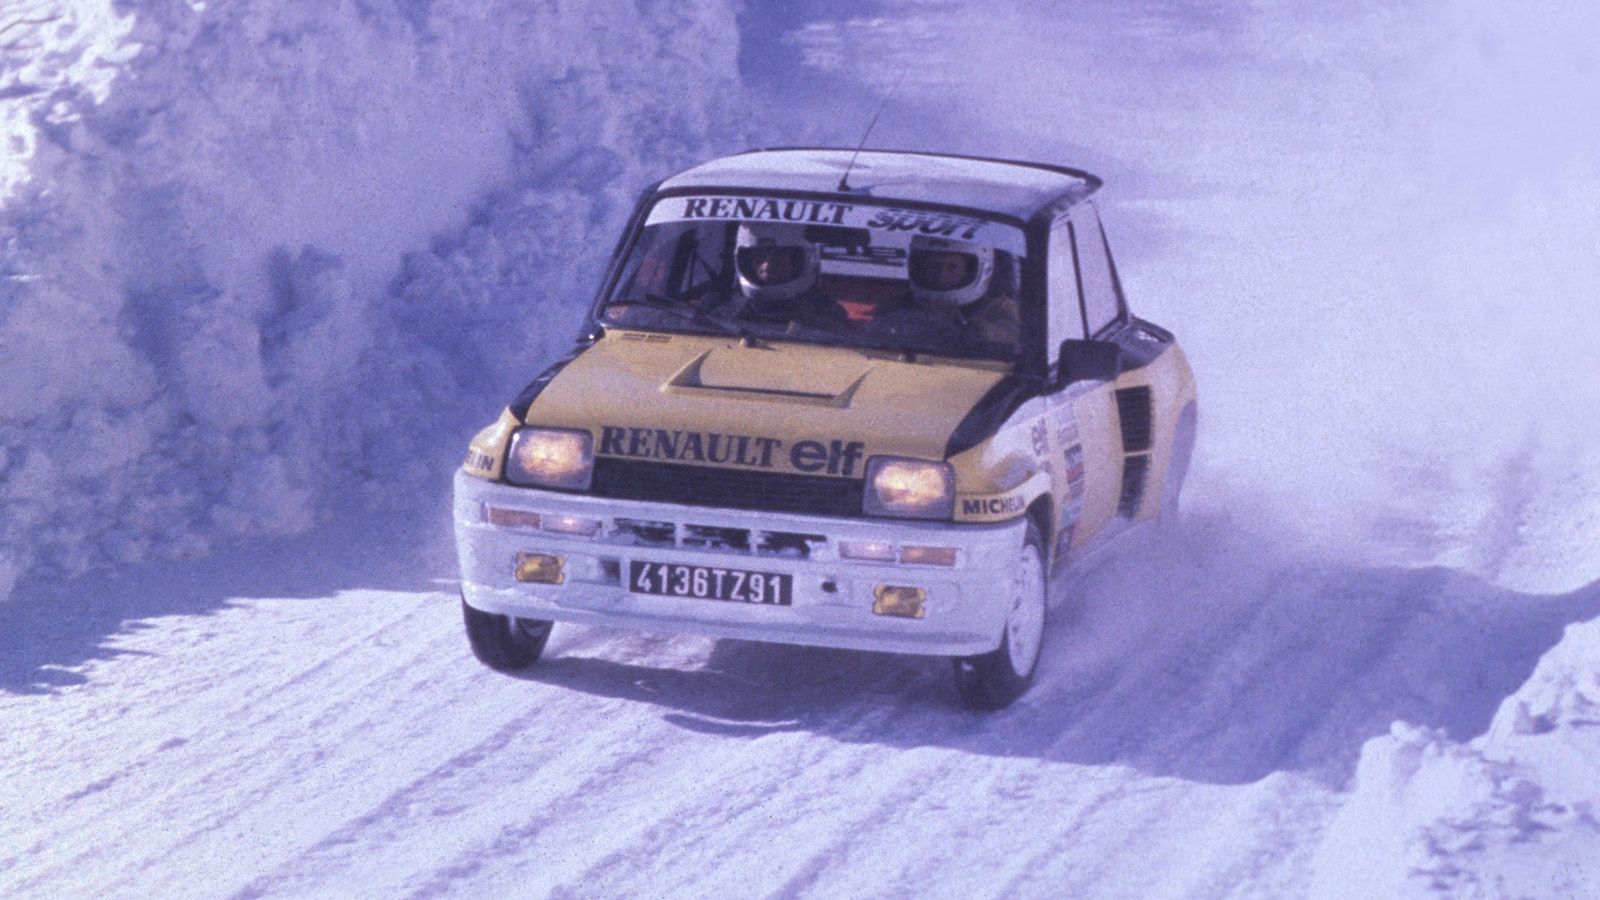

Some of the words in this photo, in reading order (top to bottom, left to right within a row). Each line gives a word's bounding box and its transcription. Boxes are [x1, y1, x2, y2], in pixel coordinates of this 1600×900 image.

[682, 197, 853, 224] RENAULT
[600, 425, 782, 467] RENAULT
[790, 439, 866, 476] elf
[637, 563, 781, 604] 4136TZ91
